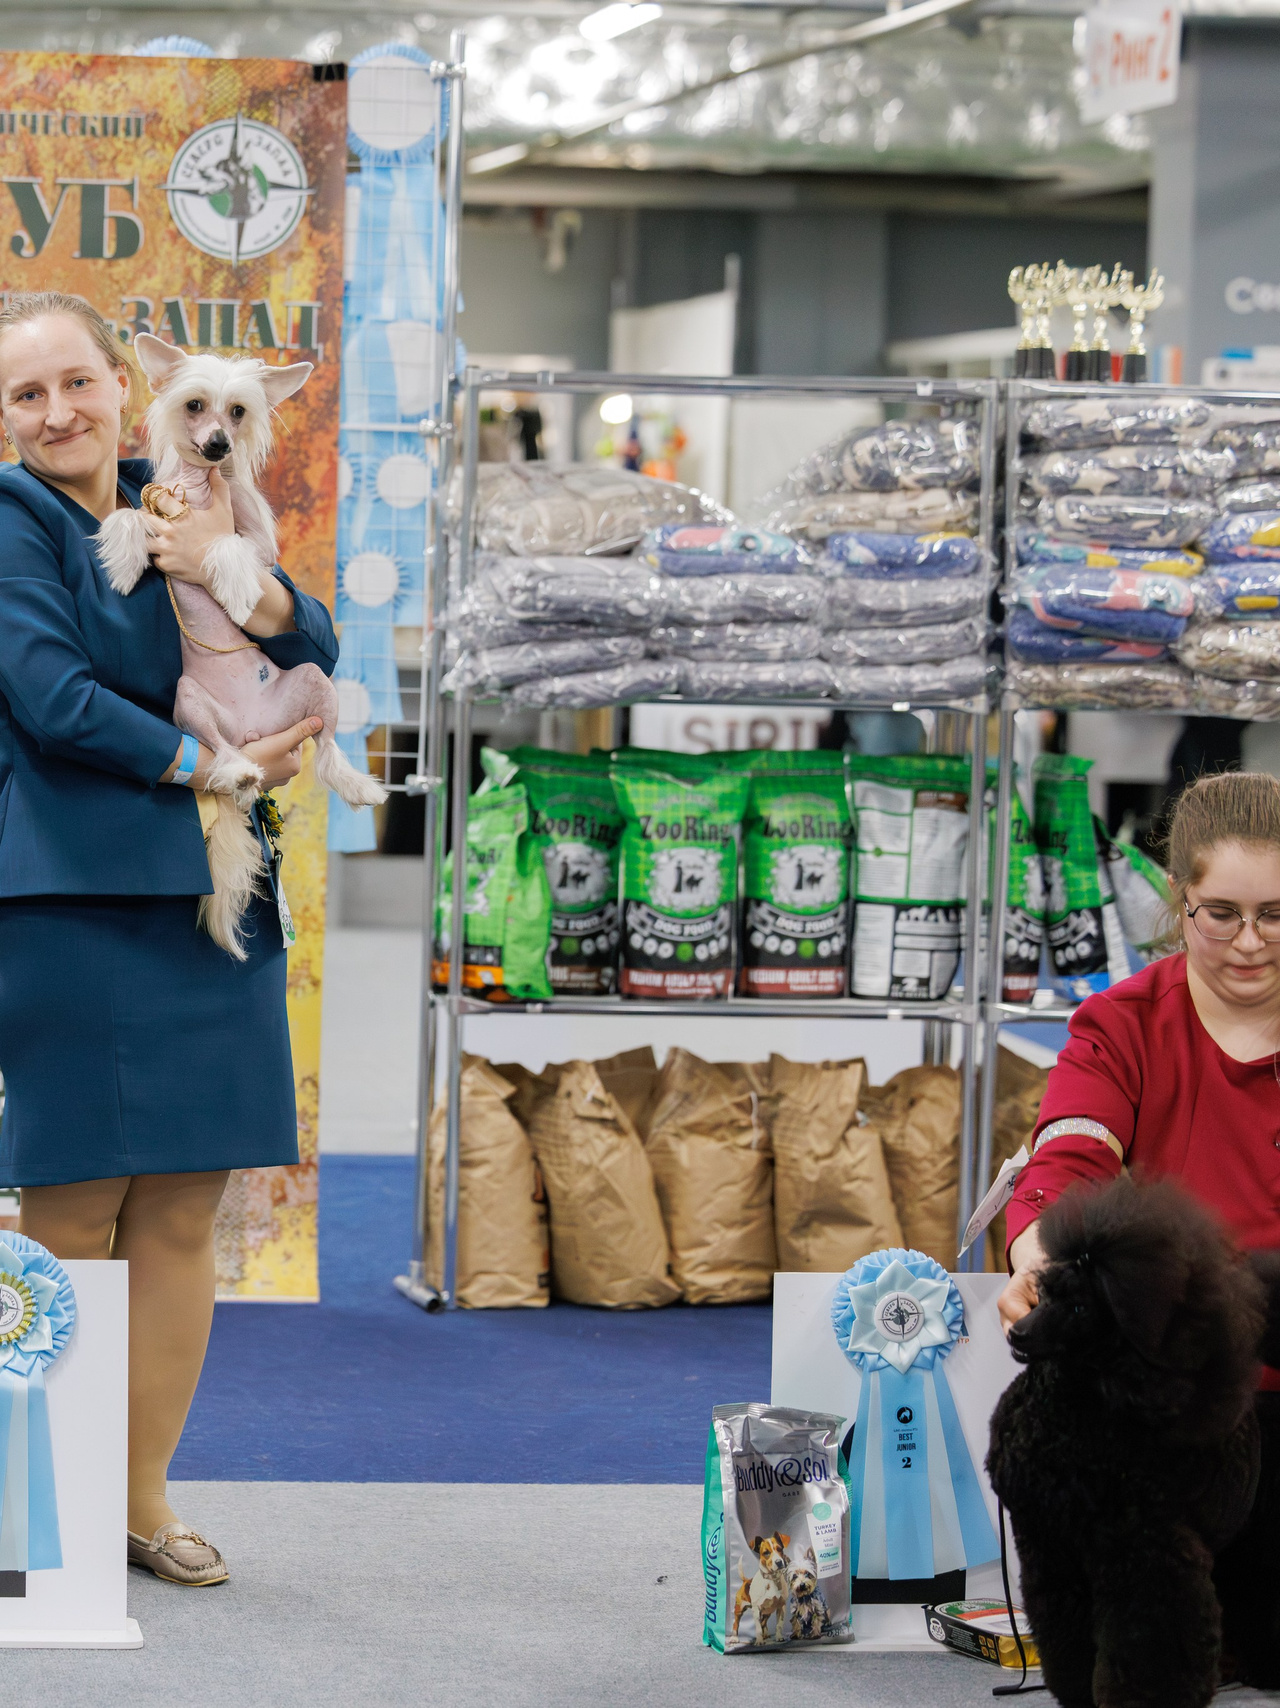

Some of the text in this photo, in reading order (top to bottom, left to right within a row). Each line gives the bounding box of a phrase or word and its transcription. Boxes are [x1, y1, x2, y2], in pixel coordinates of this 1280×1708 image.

[639, 814, 731, 849] ZooRing
[898, 1432, 913, 1441] BEST
[896, 1443, 917, 1452] JUNIOR
[901, 1456, 912, 1469] 2
[814, 1523, 837, 1531] TURKEY
